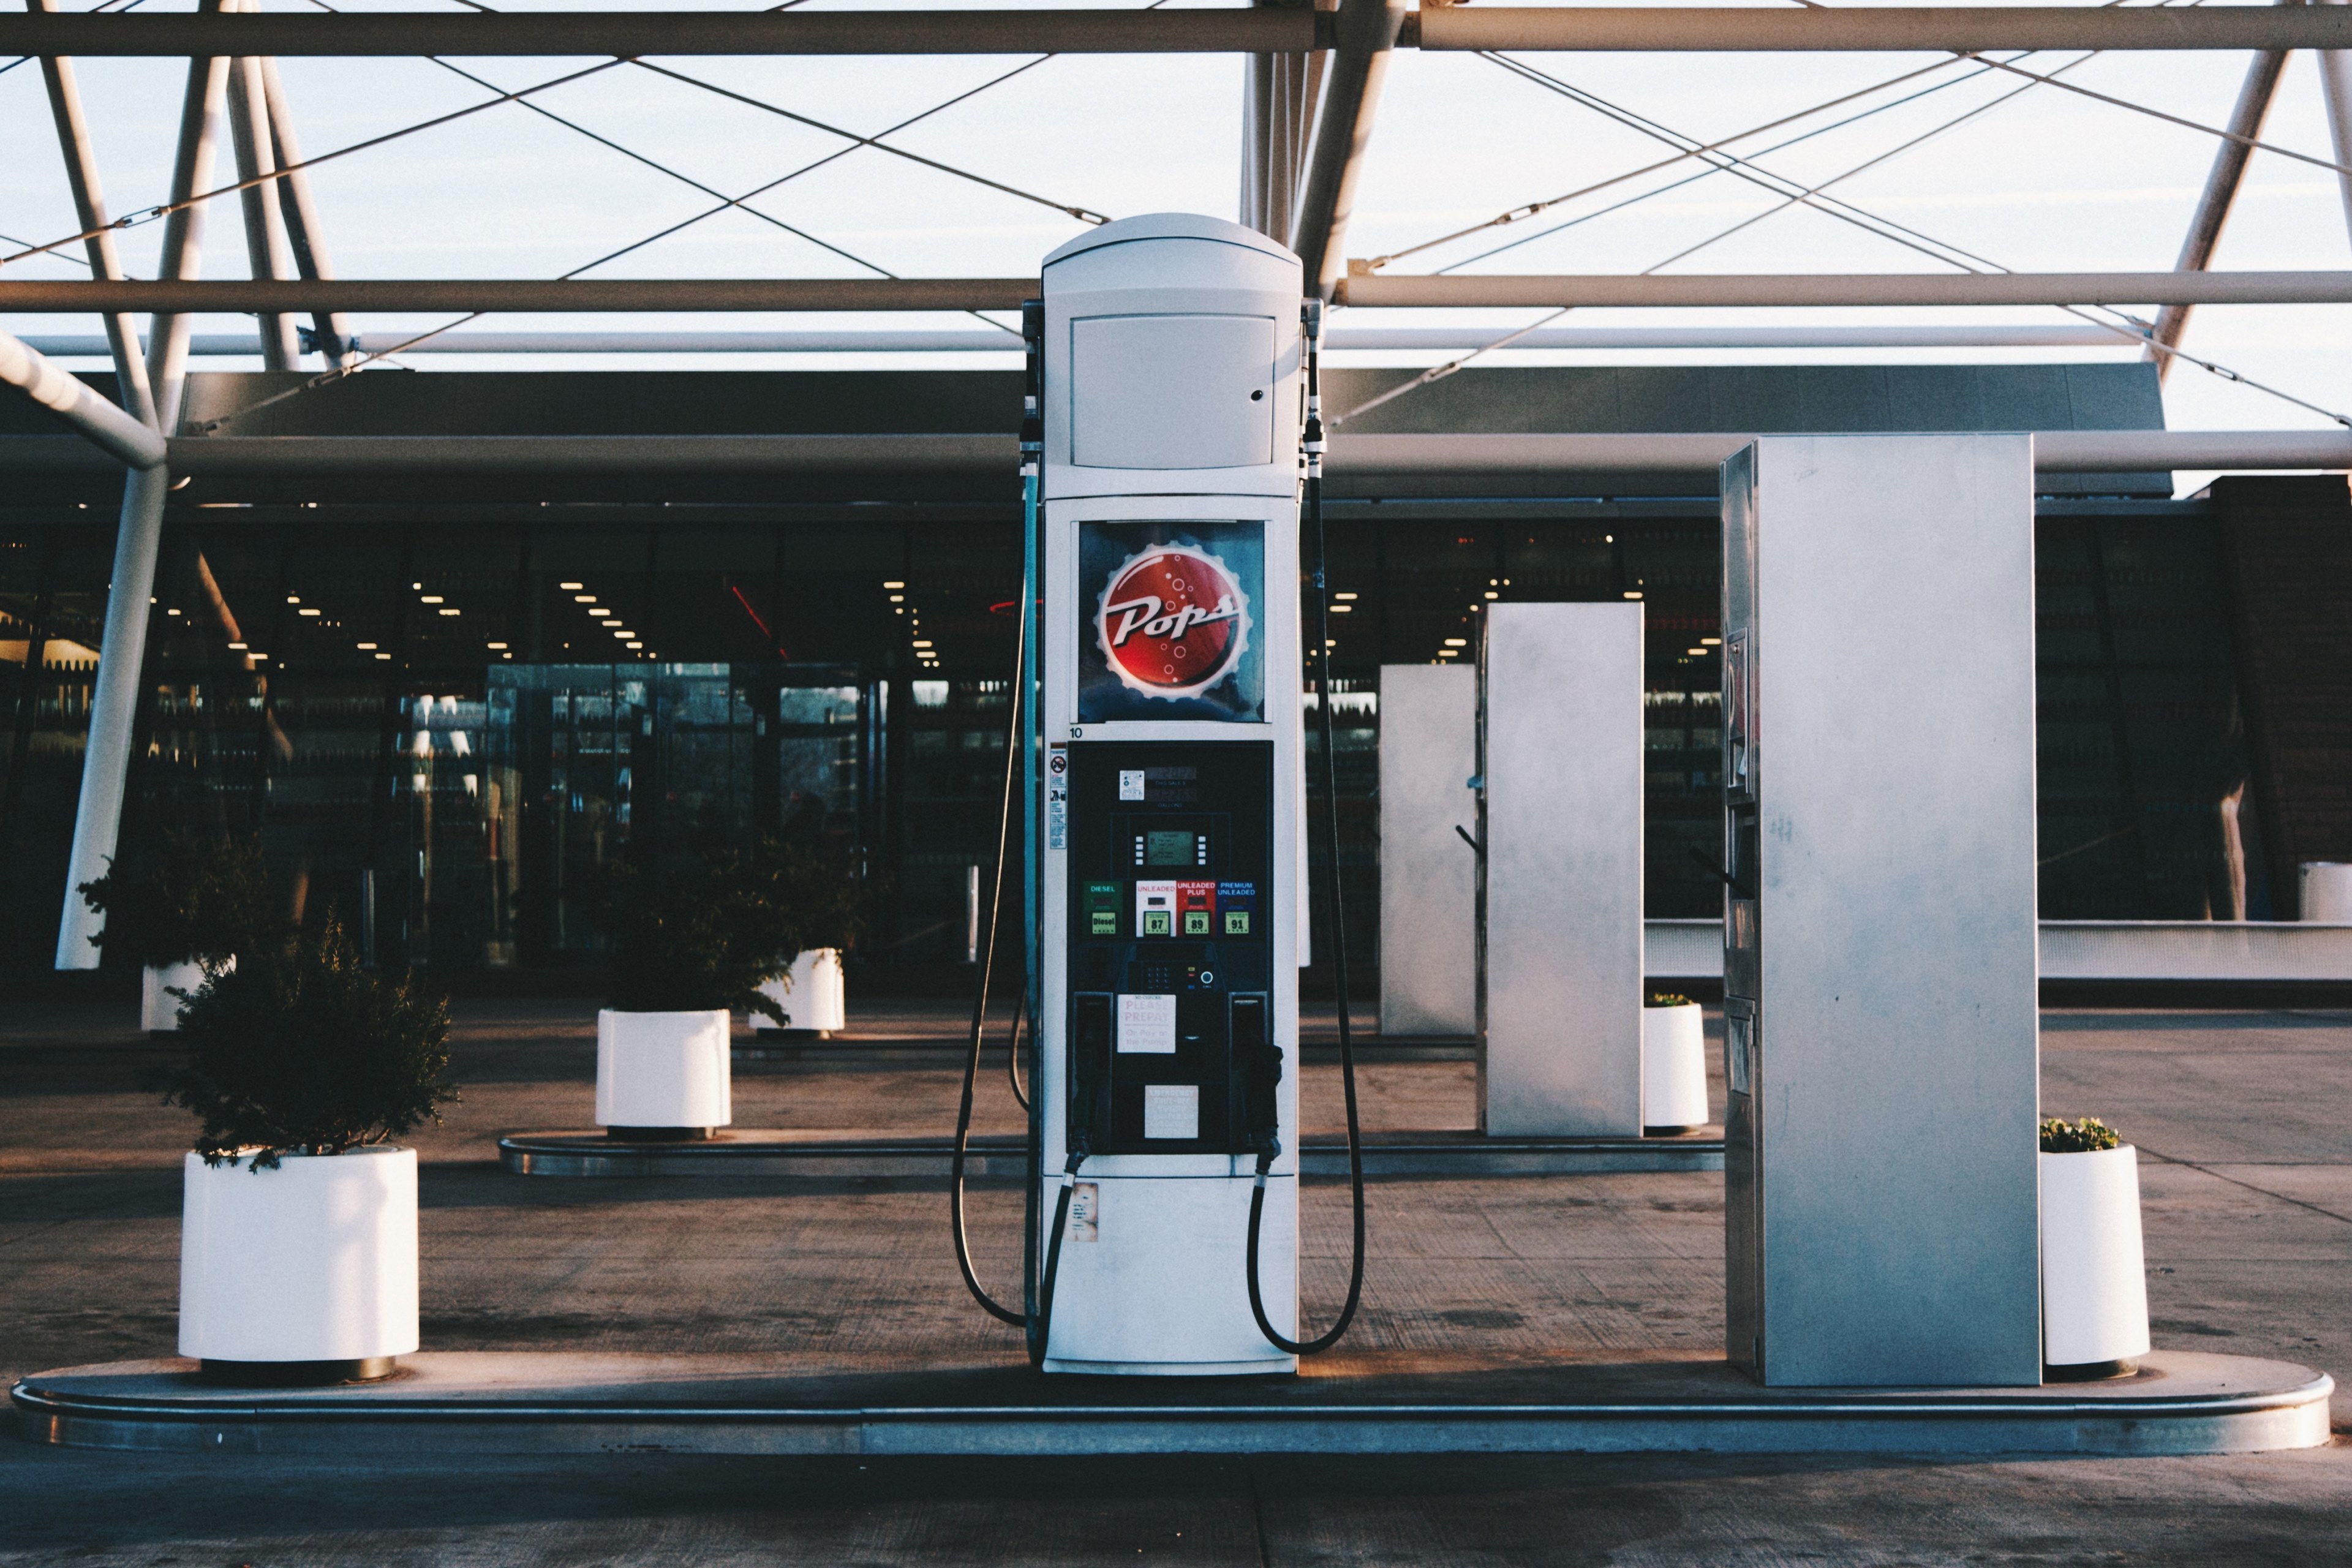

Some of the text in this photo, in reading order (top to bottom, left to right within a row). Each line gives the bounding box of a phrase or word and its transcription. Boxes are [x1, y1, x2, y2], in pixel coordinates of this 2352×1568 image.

[1106, 594, 1240, 646] Pops
[1069, 728, 1082, 738] 10
[1151, 919, 1163, 929] 87
[1191, 919, 1204, 929] 89
[1231, 919, 1243, 929] 91
[1126, 1000, 1167, 1009] PLEASE
[1125, 1012, 1167, 1021] PREPAY
